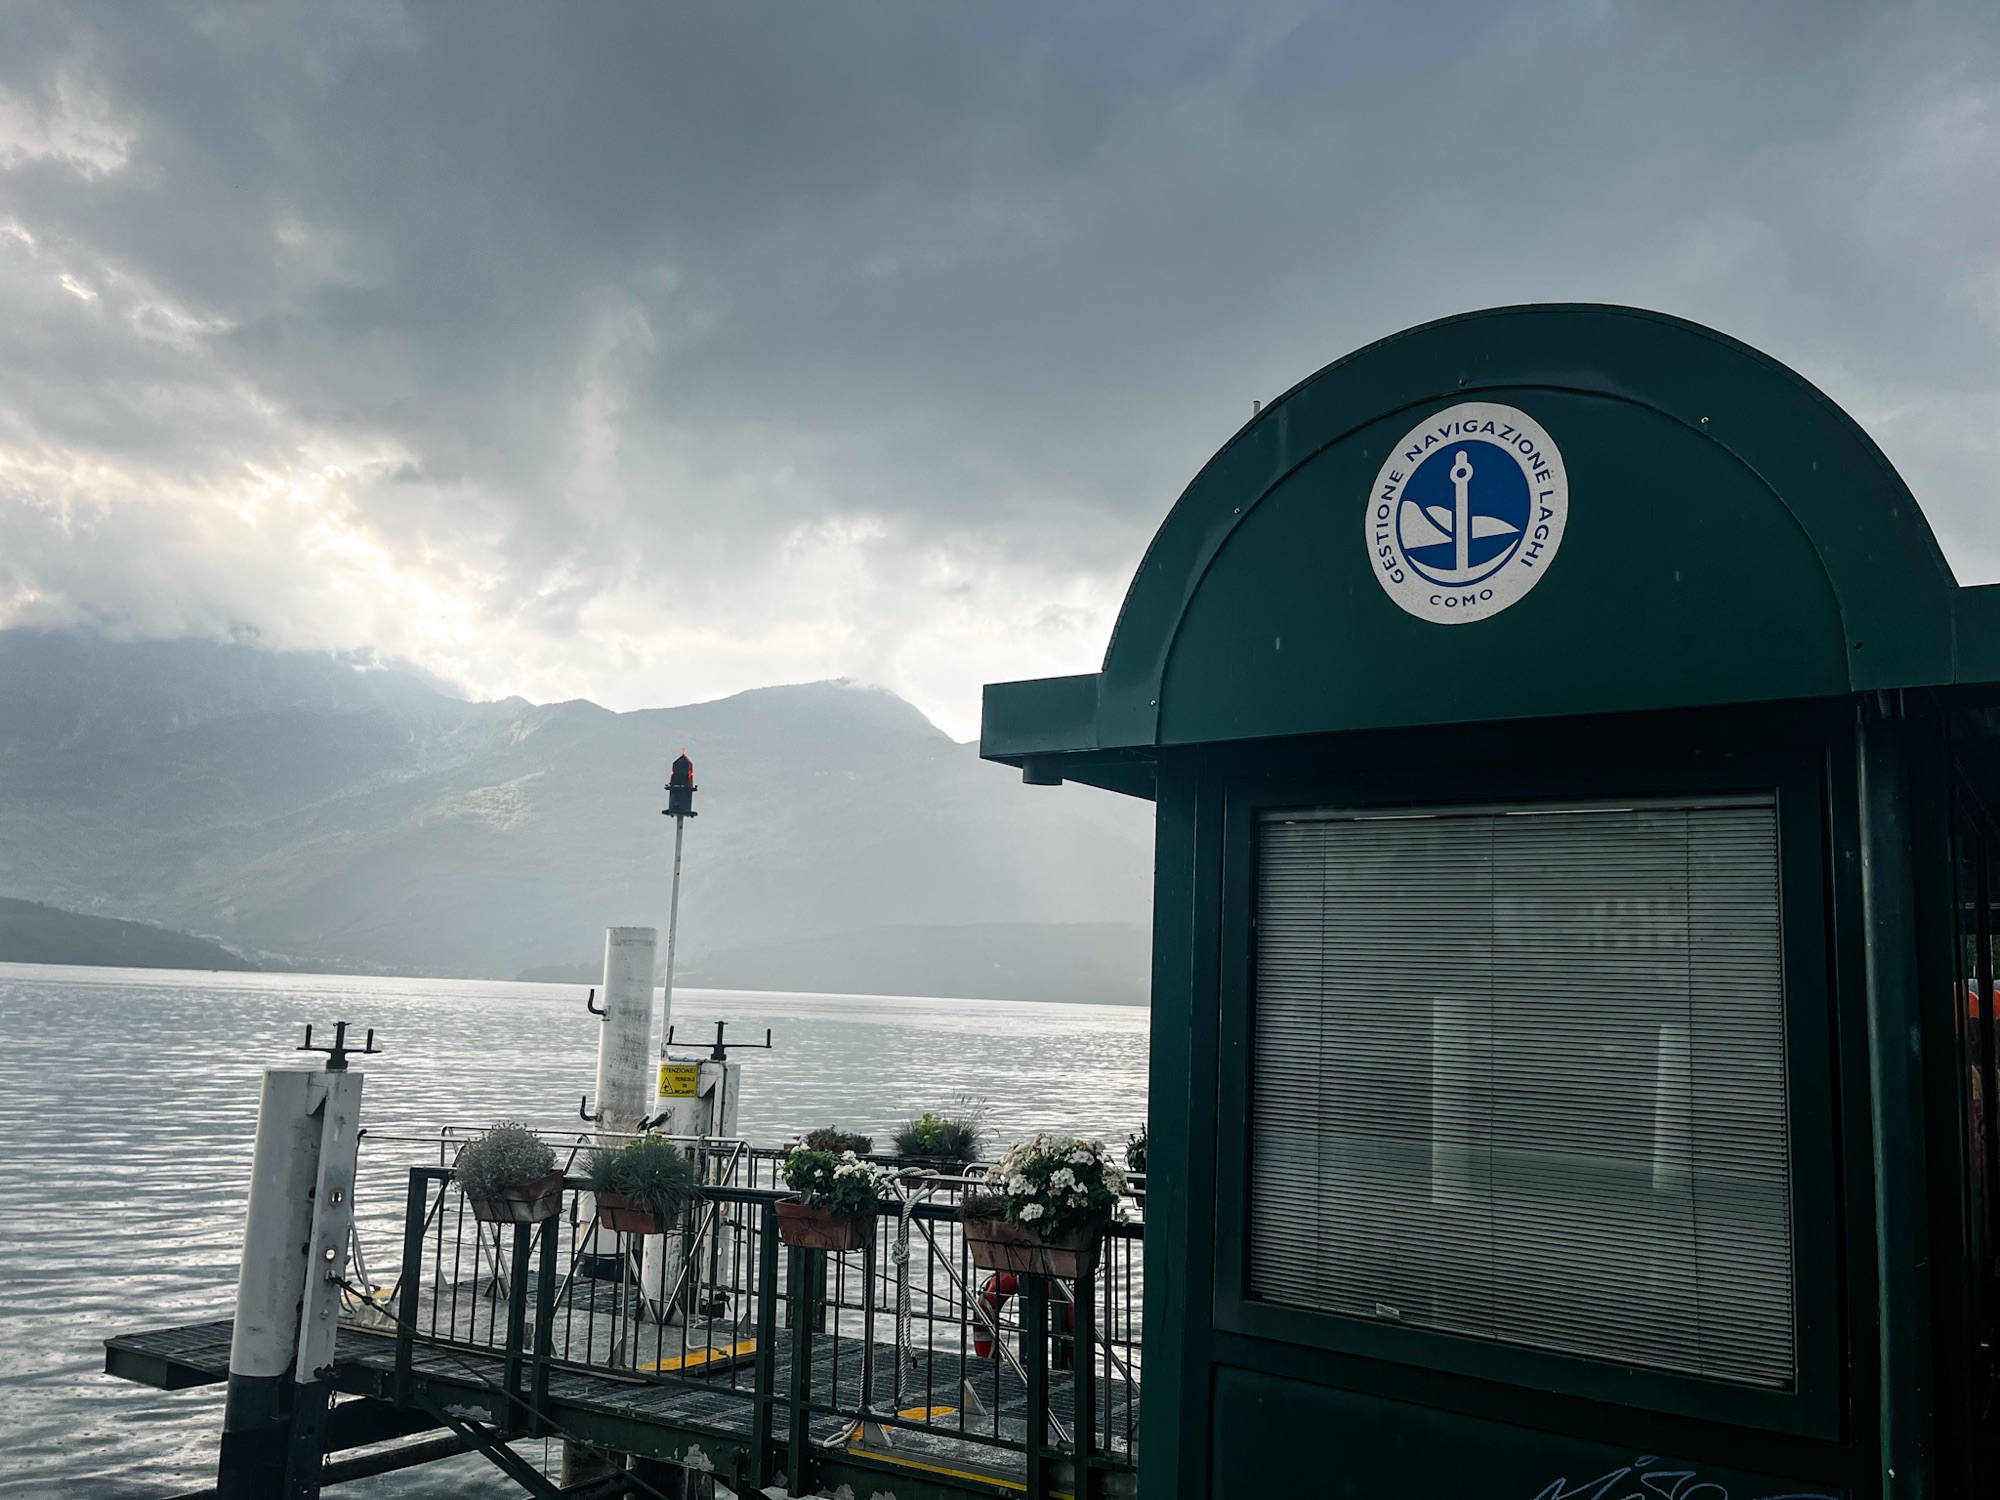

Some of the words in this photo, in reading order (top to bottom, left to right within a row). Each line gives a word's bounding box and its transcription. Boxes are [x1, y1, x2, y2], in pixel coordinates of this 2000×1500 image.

[1375, 469, 1405, 584] GESTIONE
[1405, 419, 1552, 484] NAVIGAZIONE
[1520, 489, 1554, 568] LAGHI
[1429, 588, 1493, 608] COMO
